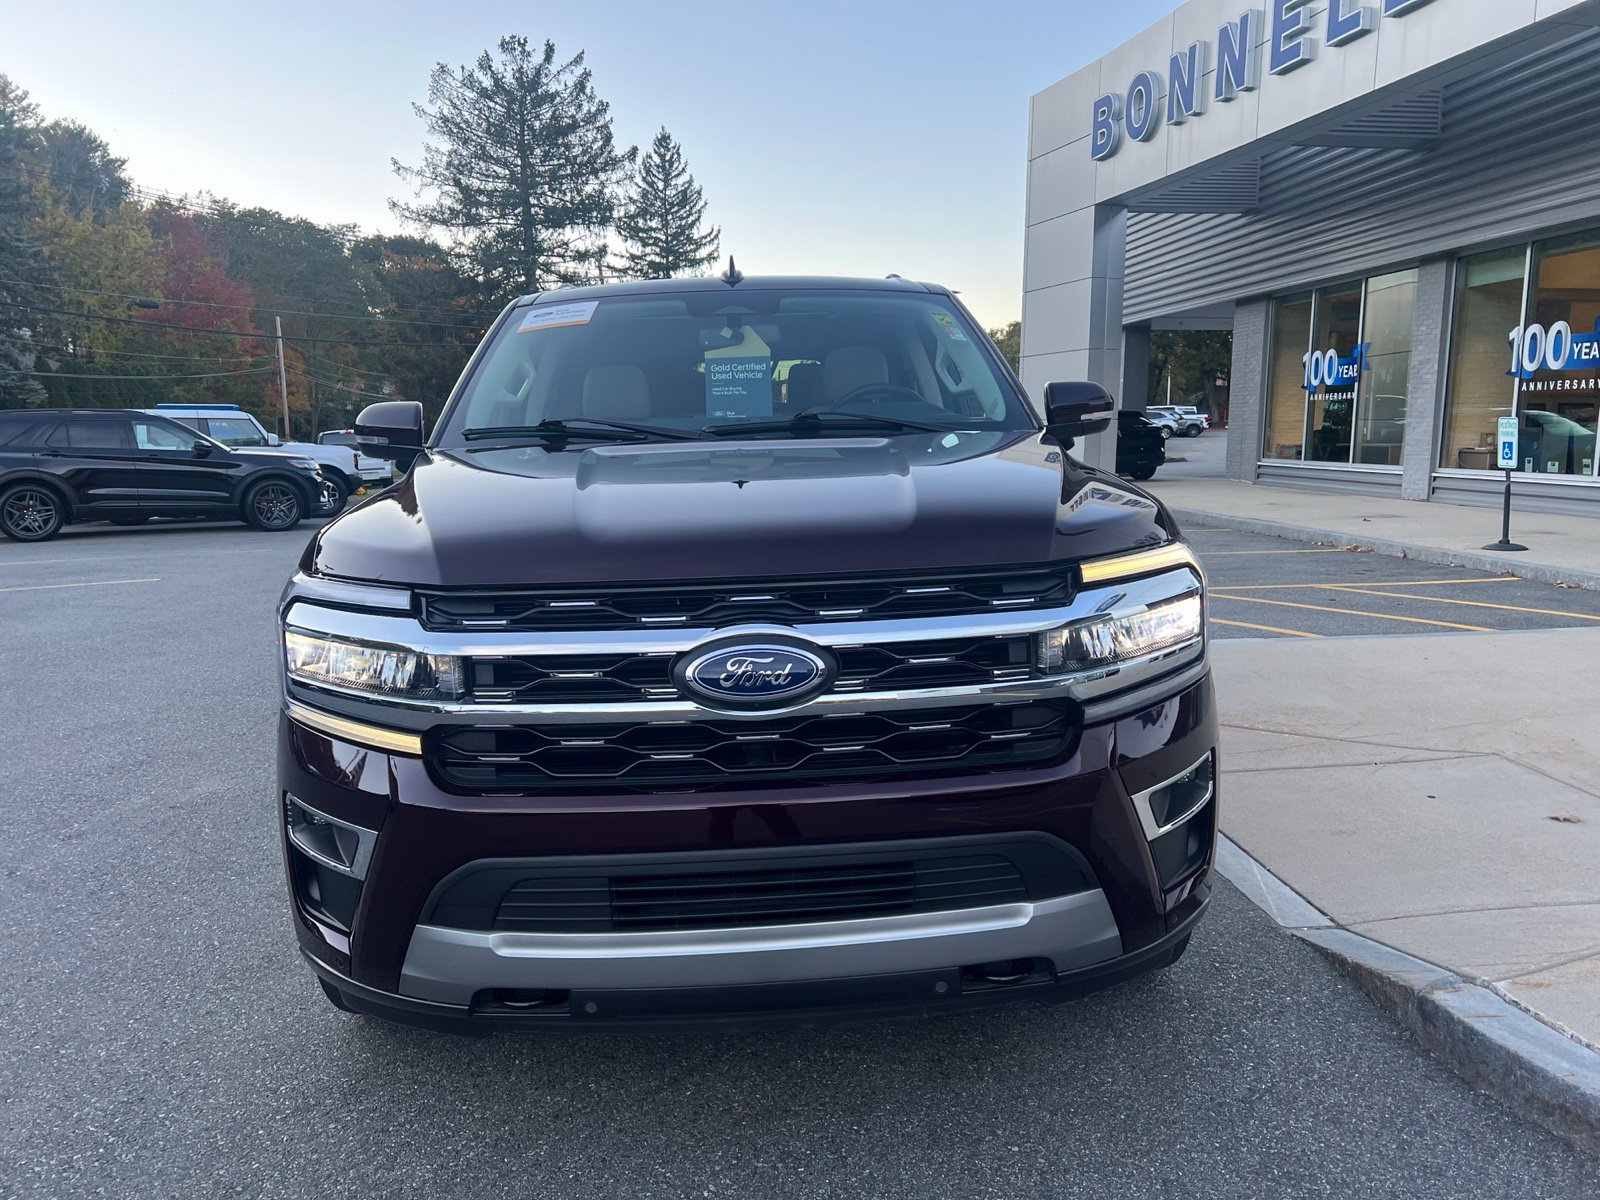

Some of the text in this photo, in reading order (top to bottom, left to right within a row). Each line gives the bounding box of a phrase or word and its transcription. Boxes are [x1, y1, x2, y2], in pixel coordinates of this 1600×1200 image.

[1090, 0, 1438, 161] BONNEL
[1508, 320, 1572, 372] 100
[711, 363, 766, 372] Gold Certified
[1302, 348, 1339, 387] 100
[719, 656, 793, 688] Ford
